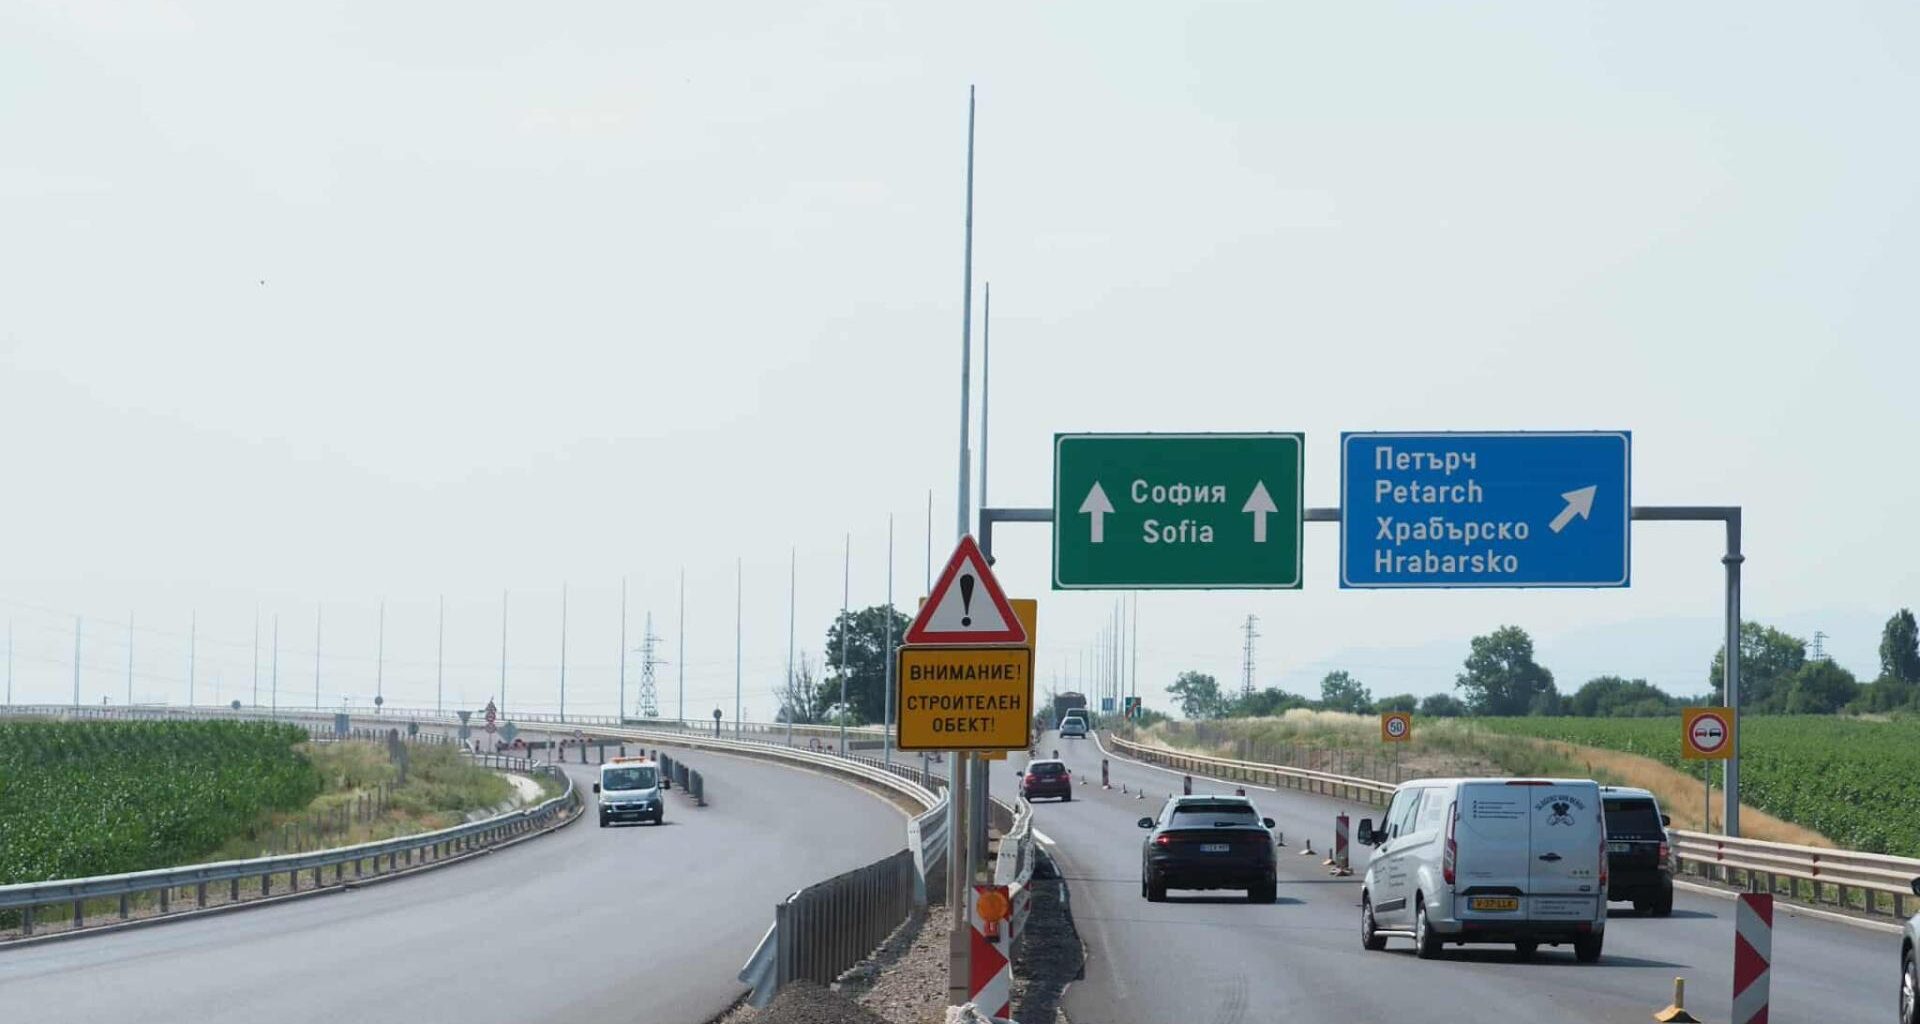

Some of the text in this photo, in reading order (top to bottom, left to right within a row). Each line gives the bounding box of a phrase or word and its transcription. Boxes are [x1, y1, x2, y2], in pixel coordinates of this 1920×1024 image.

[1375, 446, 1476, 475] Петърч
[1131, 479, 1226, 507] София
[1375, 479, 1483, 503] Petarch
[1143, 519, 1214, 544] Sofia
[1376, 516, 1529, 545] Храбърско
[1375, 549, 1518, 573] Hrabarsko
[910, 664, 1021, 681] ВНИМАНИЕ!
[907, 694, 1021, 711] СТРОИТЕЛЕН
[932, 717, 995, 733] ОБЕКТ!
[1390, 721, 1403, 732] 50
